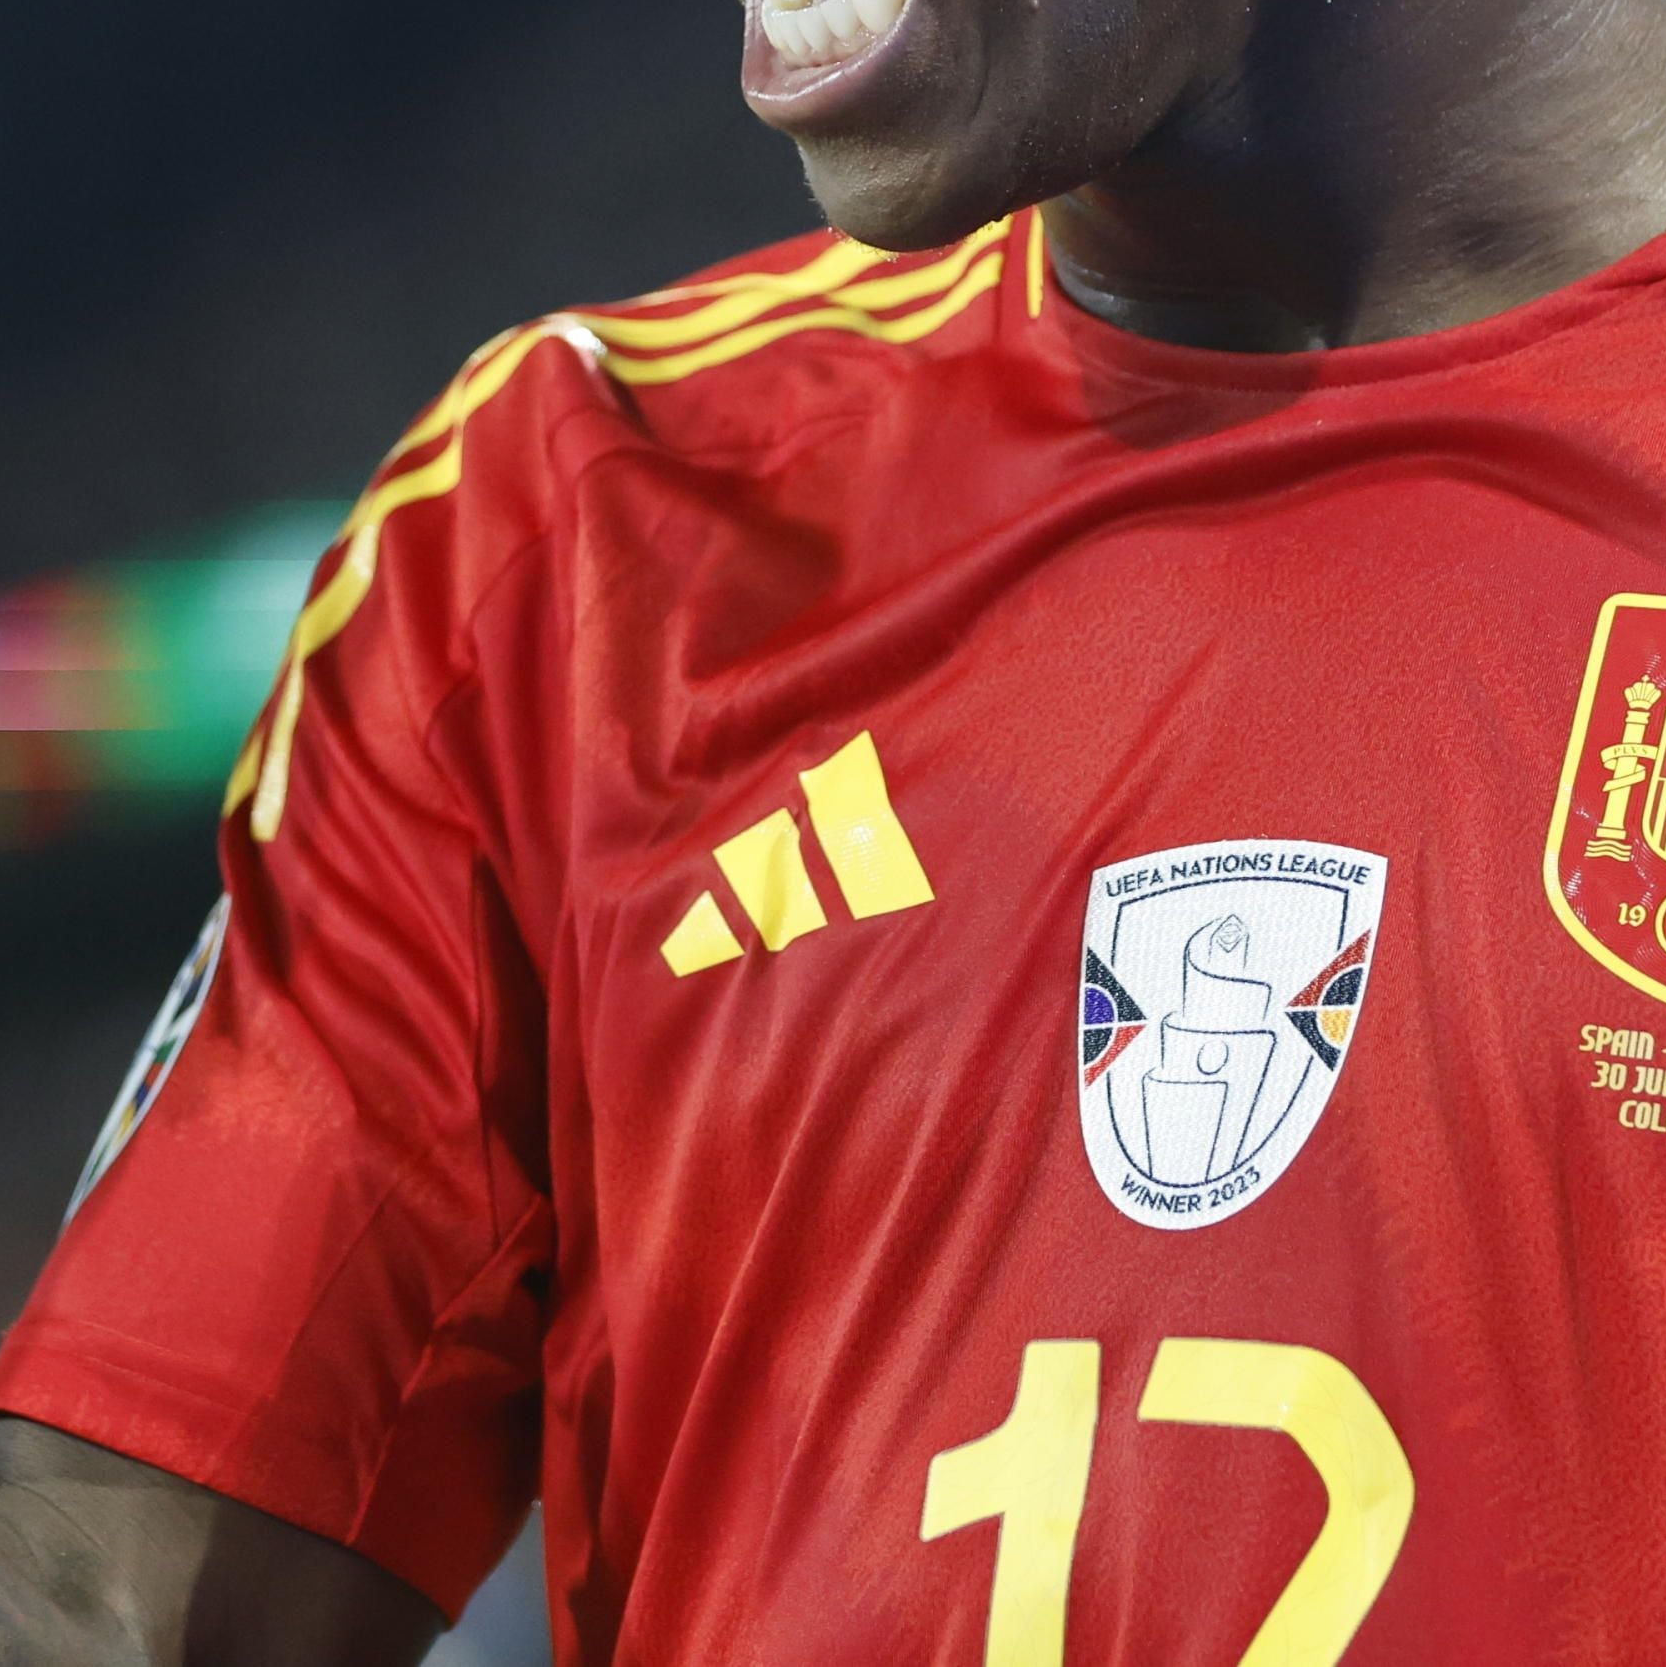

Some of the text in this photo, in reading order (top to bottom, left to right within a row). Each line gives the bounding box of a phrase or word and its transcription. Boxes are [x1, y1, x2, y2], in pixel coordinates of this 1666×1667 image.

[1106, 853, 1371, 898] UEFA NATIONS LEAGUE
[1617, 902, 1647, 927] 19
[1579, 1024, 1655, 1061] SPAIN
[1591, 1060, 1628, 1091] 30
[1121, 1166, 1261, 1214] WINNER 2023
